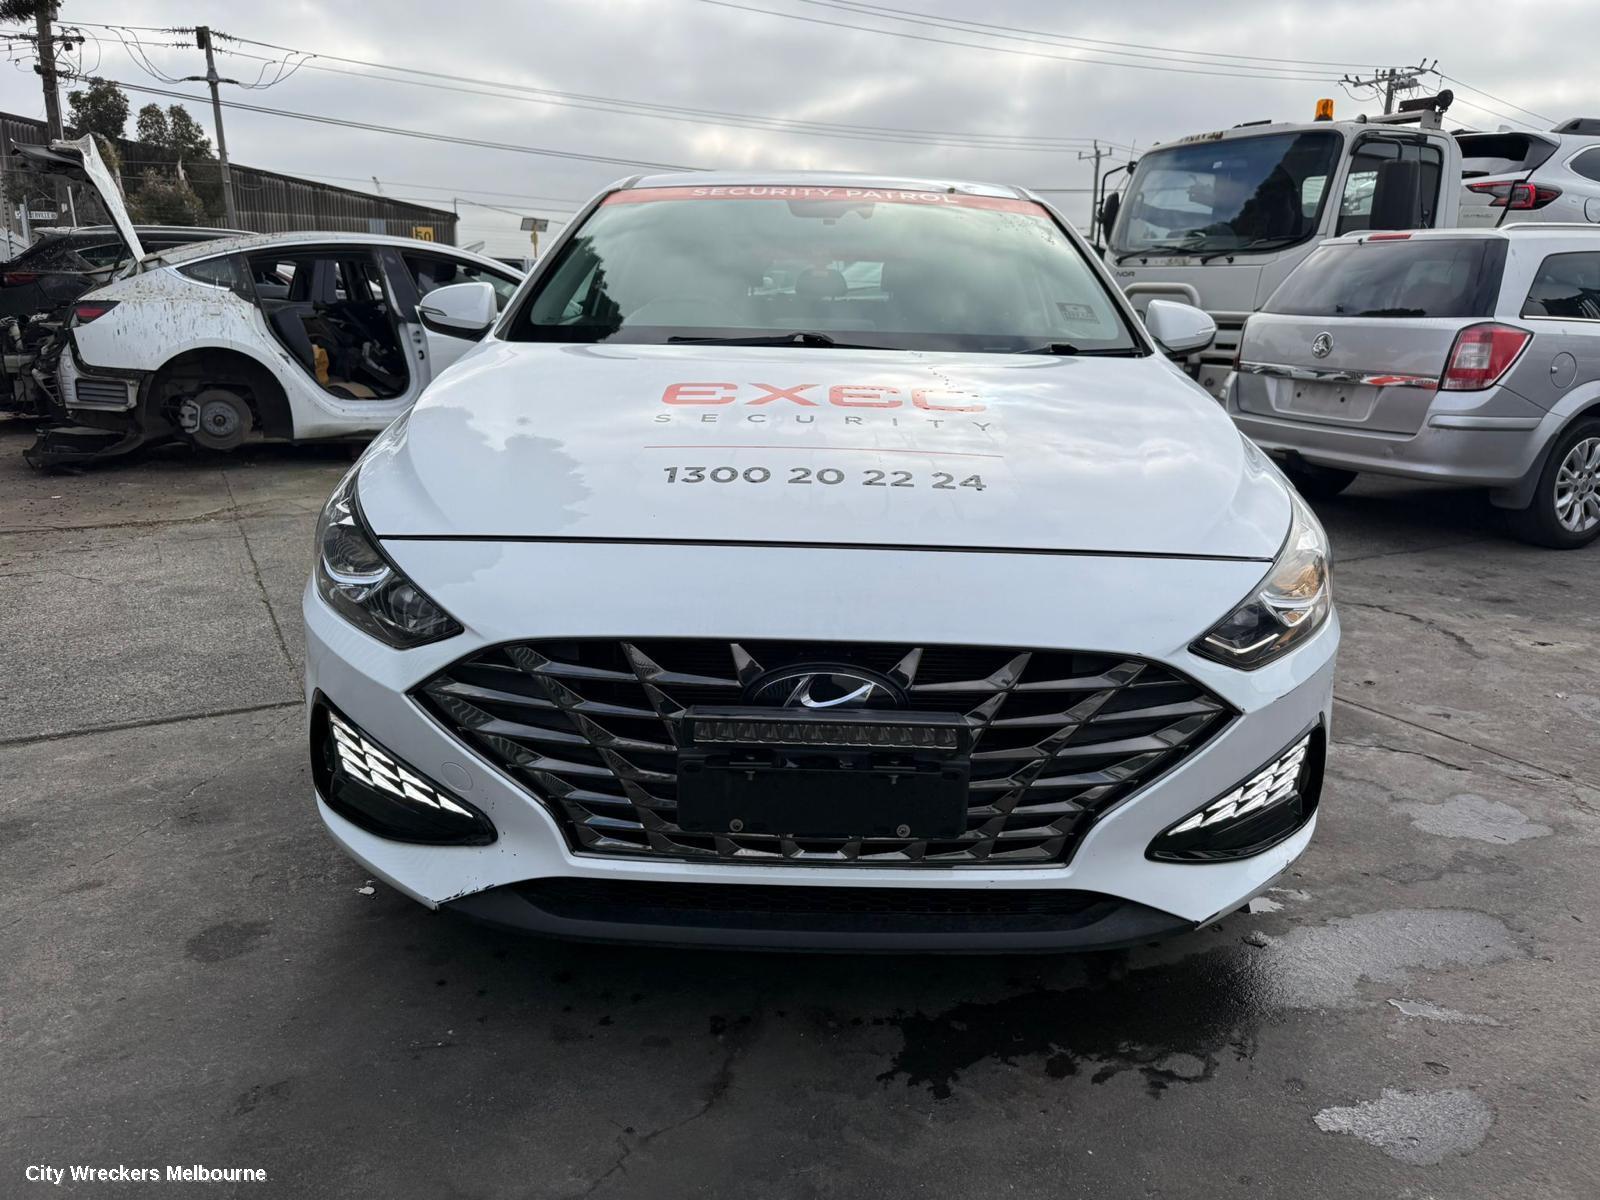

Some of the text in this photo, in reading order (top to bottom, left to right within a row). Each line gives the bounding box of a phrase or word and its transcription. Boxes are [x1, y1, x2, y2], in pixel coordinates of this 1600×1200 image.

[691, 187, 959, 204] SECURITY PATROL
[653, 413, 991, 432] SECURITY
[663, 466, 987, 491] 1300 20 22 24
